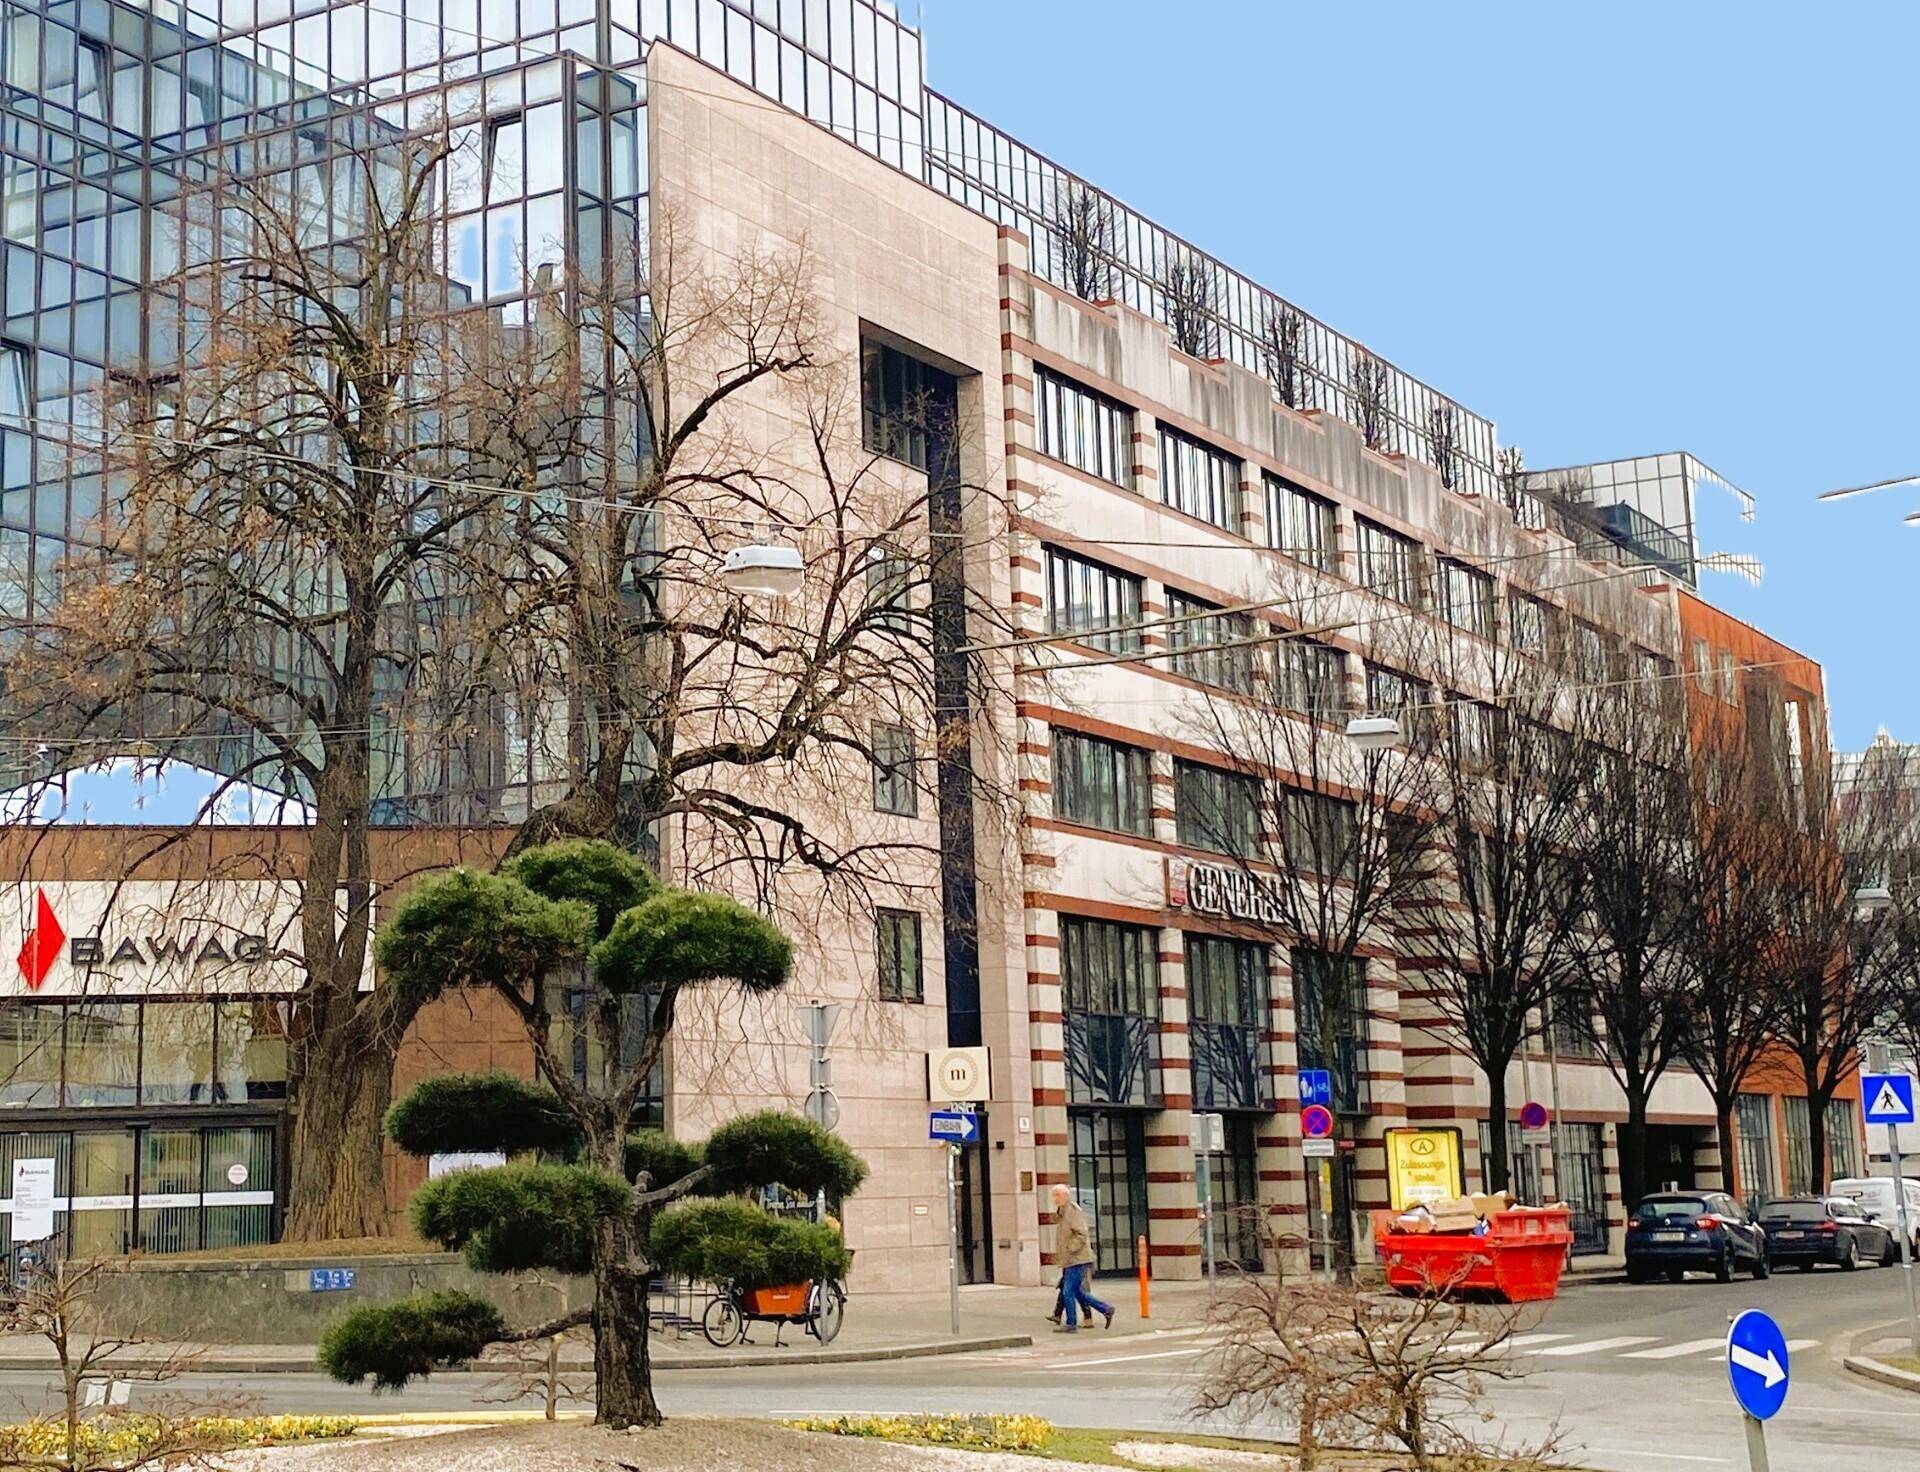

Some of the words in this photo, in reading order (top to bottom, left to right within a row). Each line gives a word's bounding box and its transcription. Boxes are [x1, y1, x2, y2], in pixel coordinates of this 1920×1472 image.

[71, 935, 267, 966] BAWAG
[950, 1068, 966, 1081] m
[1418, 1141, 1428, 1152] A
